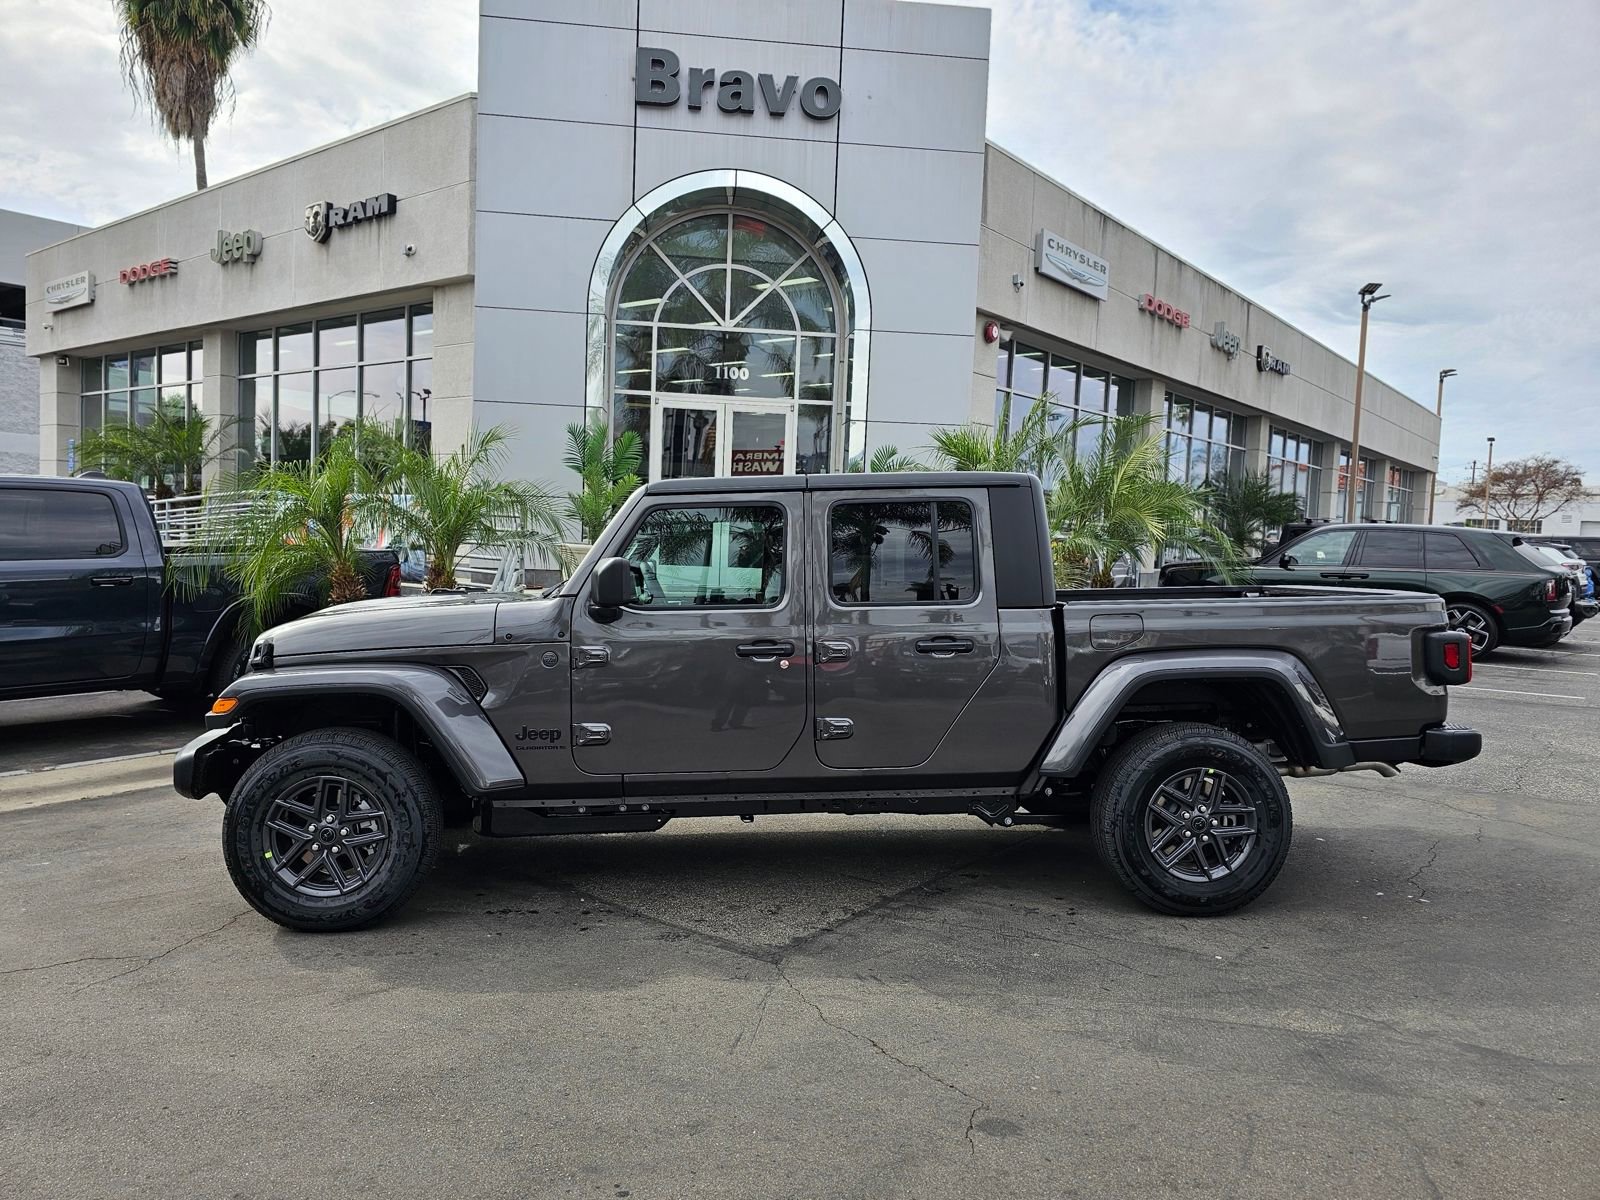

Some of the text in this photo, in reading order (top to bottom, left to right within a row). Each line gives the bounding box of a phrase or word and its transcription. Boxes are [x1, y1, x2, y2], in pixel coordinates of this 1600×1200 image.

[635, 47, 842, 120] Bravo
[329, 193, 391, 228] RAM
[210, 229, 261, 264] Jeep
[1047, 237, 1107, 275] CHRYSLER
[46, 276, 86, 295] CHRYSLER
[119, 258, 174, 285] DODGE
[1143, 293, 1190, 329] DODGE
[1213, 321, 1241, 360] Jeep
[715, 366, 750, 380] 1100
[1269, 356, 1291, 376] RAM
[515, 725, 562, 743] Jeep
